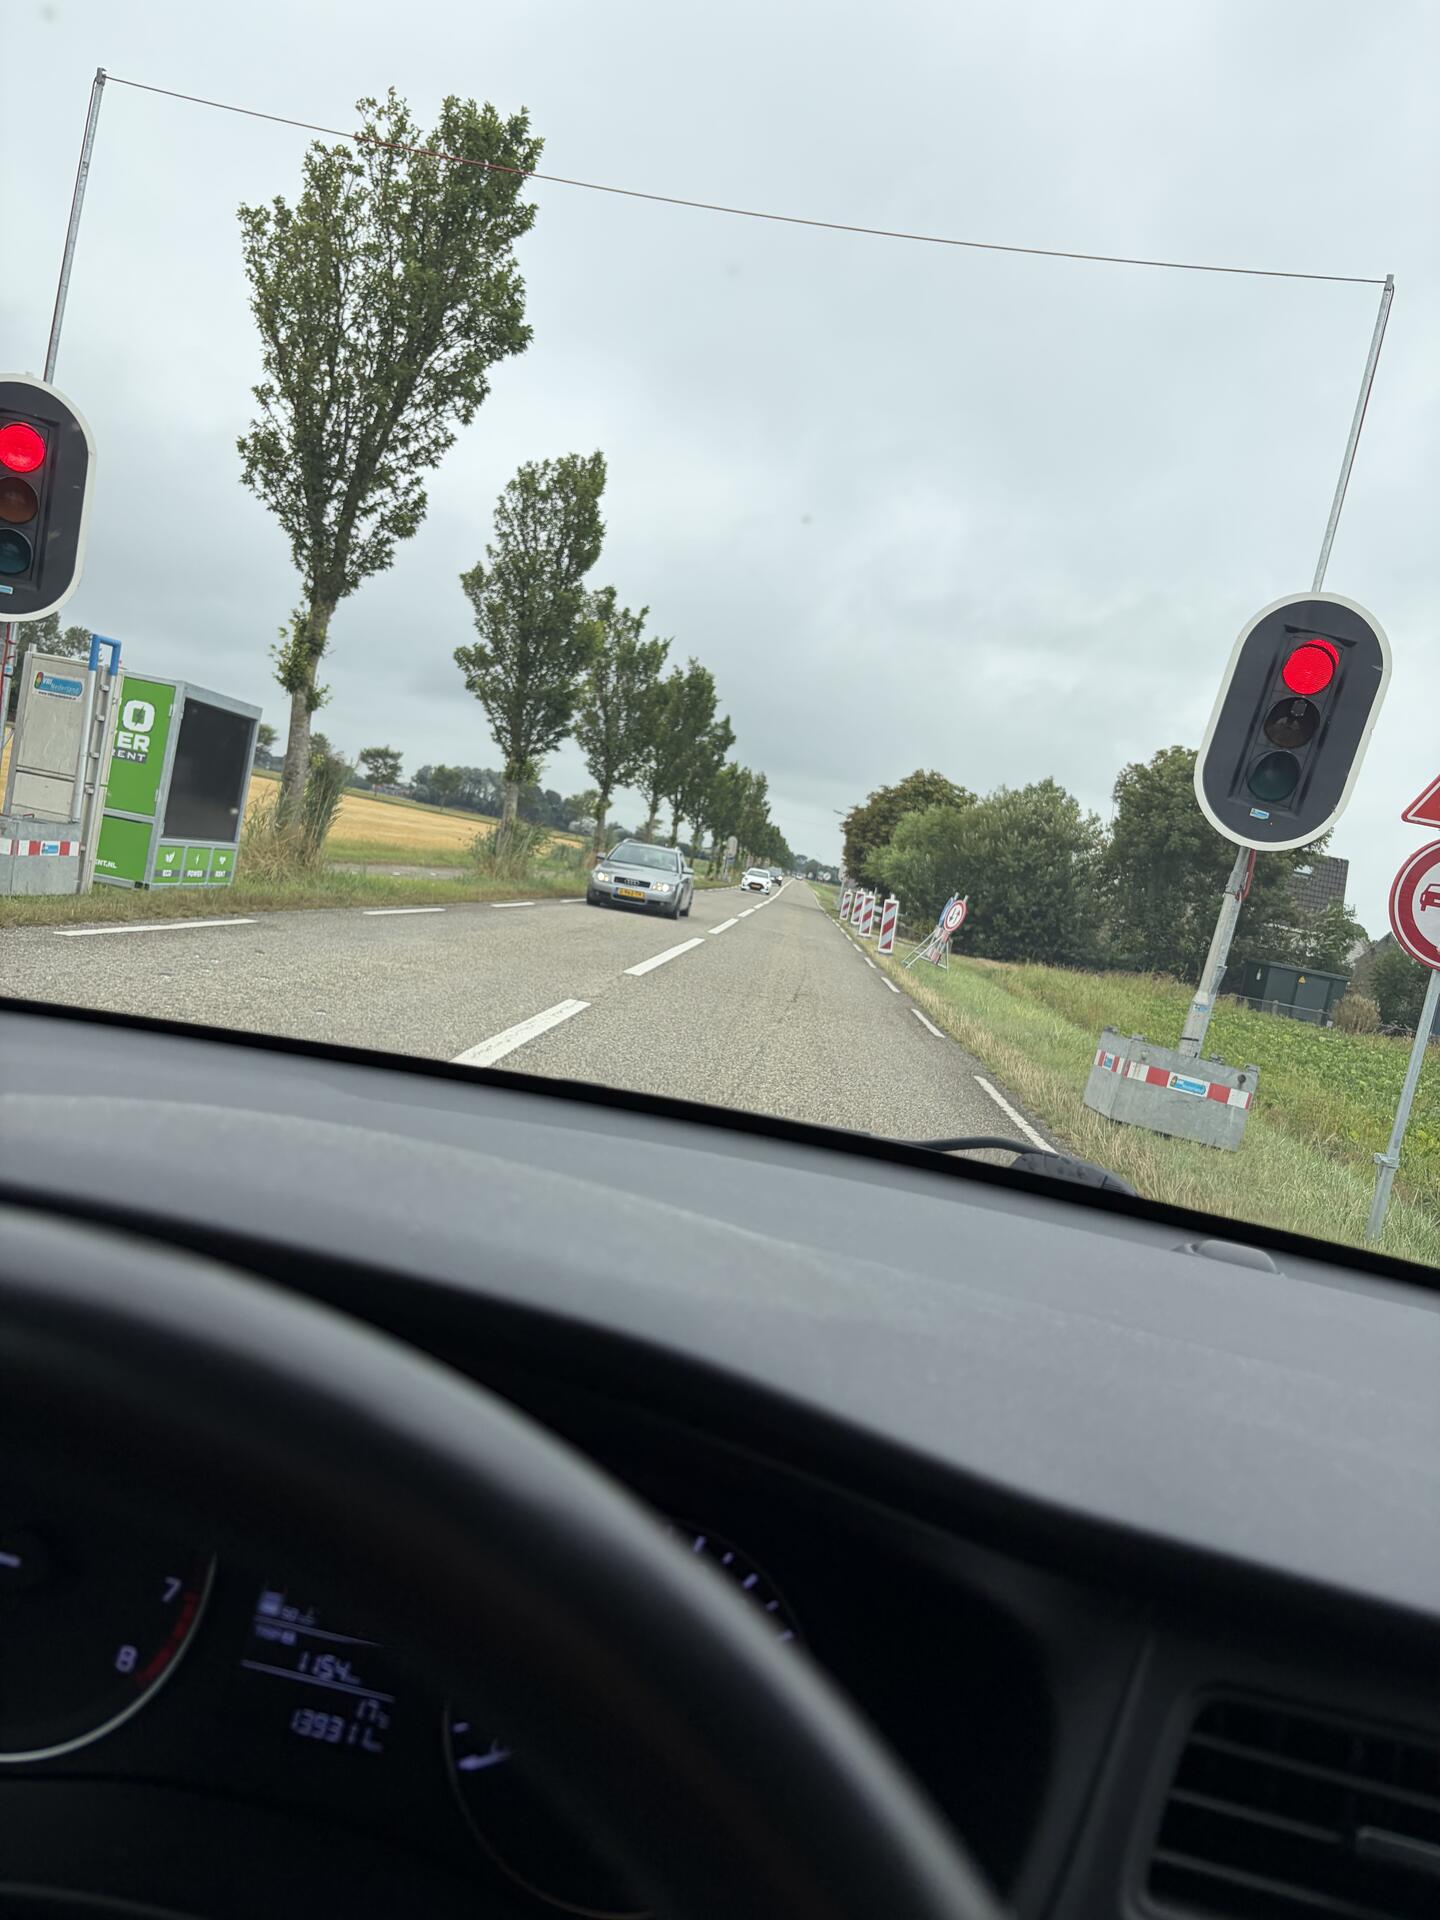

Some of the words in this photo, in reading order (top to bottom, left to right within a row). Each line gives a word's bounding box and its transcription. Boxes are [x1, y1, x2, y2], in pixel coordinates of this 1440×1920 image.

[113, 730, 151, 753] ER
[163, 1576, 182, 1602] 7
[115, 1644, 138, 1672] 8
